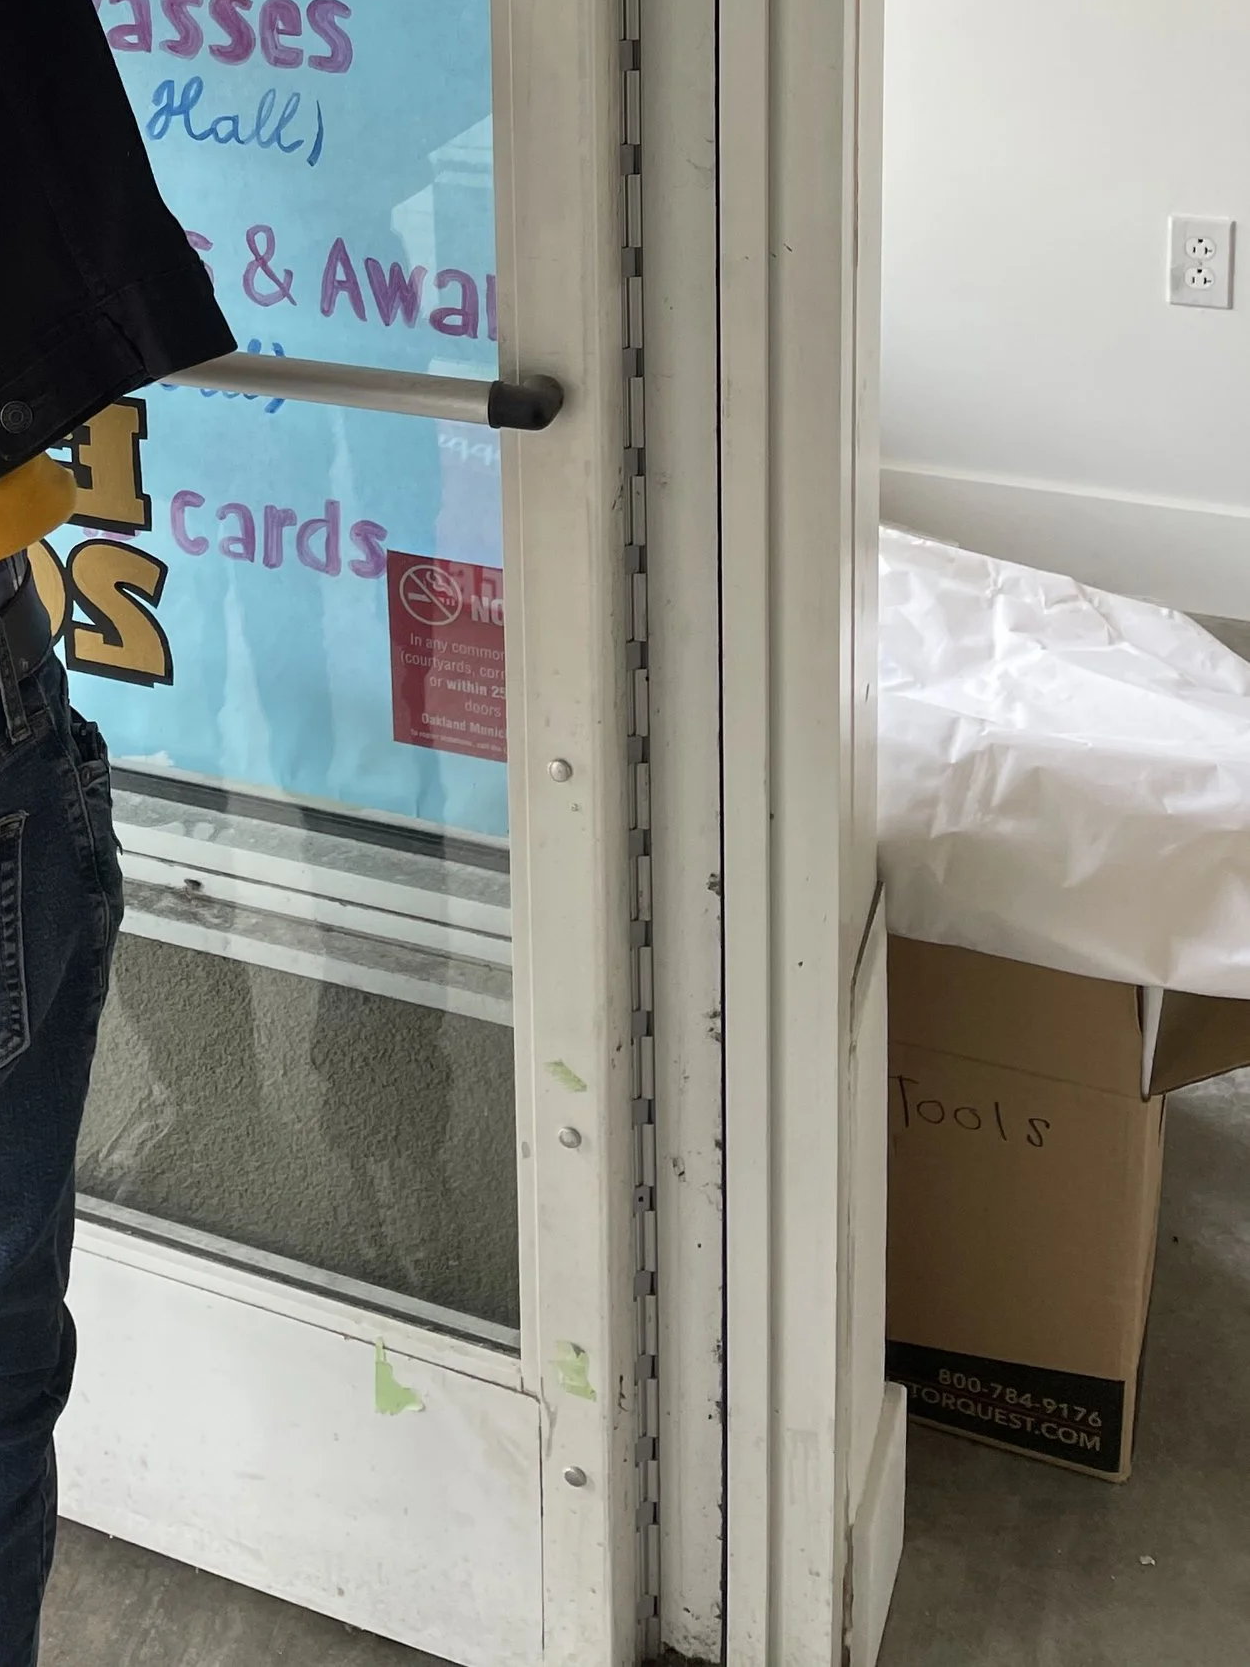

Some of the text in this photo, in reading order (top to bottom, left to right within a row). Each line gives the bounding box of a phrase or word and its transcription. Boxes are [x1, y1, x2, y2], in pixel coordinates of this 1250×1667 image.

[242, 224, 298, 308] &
[410, 632, 422, 646] In
[426, 637, 448, 654] any
[400, 649, 475, 677] (courtyards,
[429, 675, 443, 688] or
[446, 677, 488, 697] within
[463, 698, 502, 719] doors
[421, 712, 467, 731] Oakland
[938, 1367, 1103, 1428] 800-784-9176
[898, 1379, 1102, 1453] TORQUEST.COM
